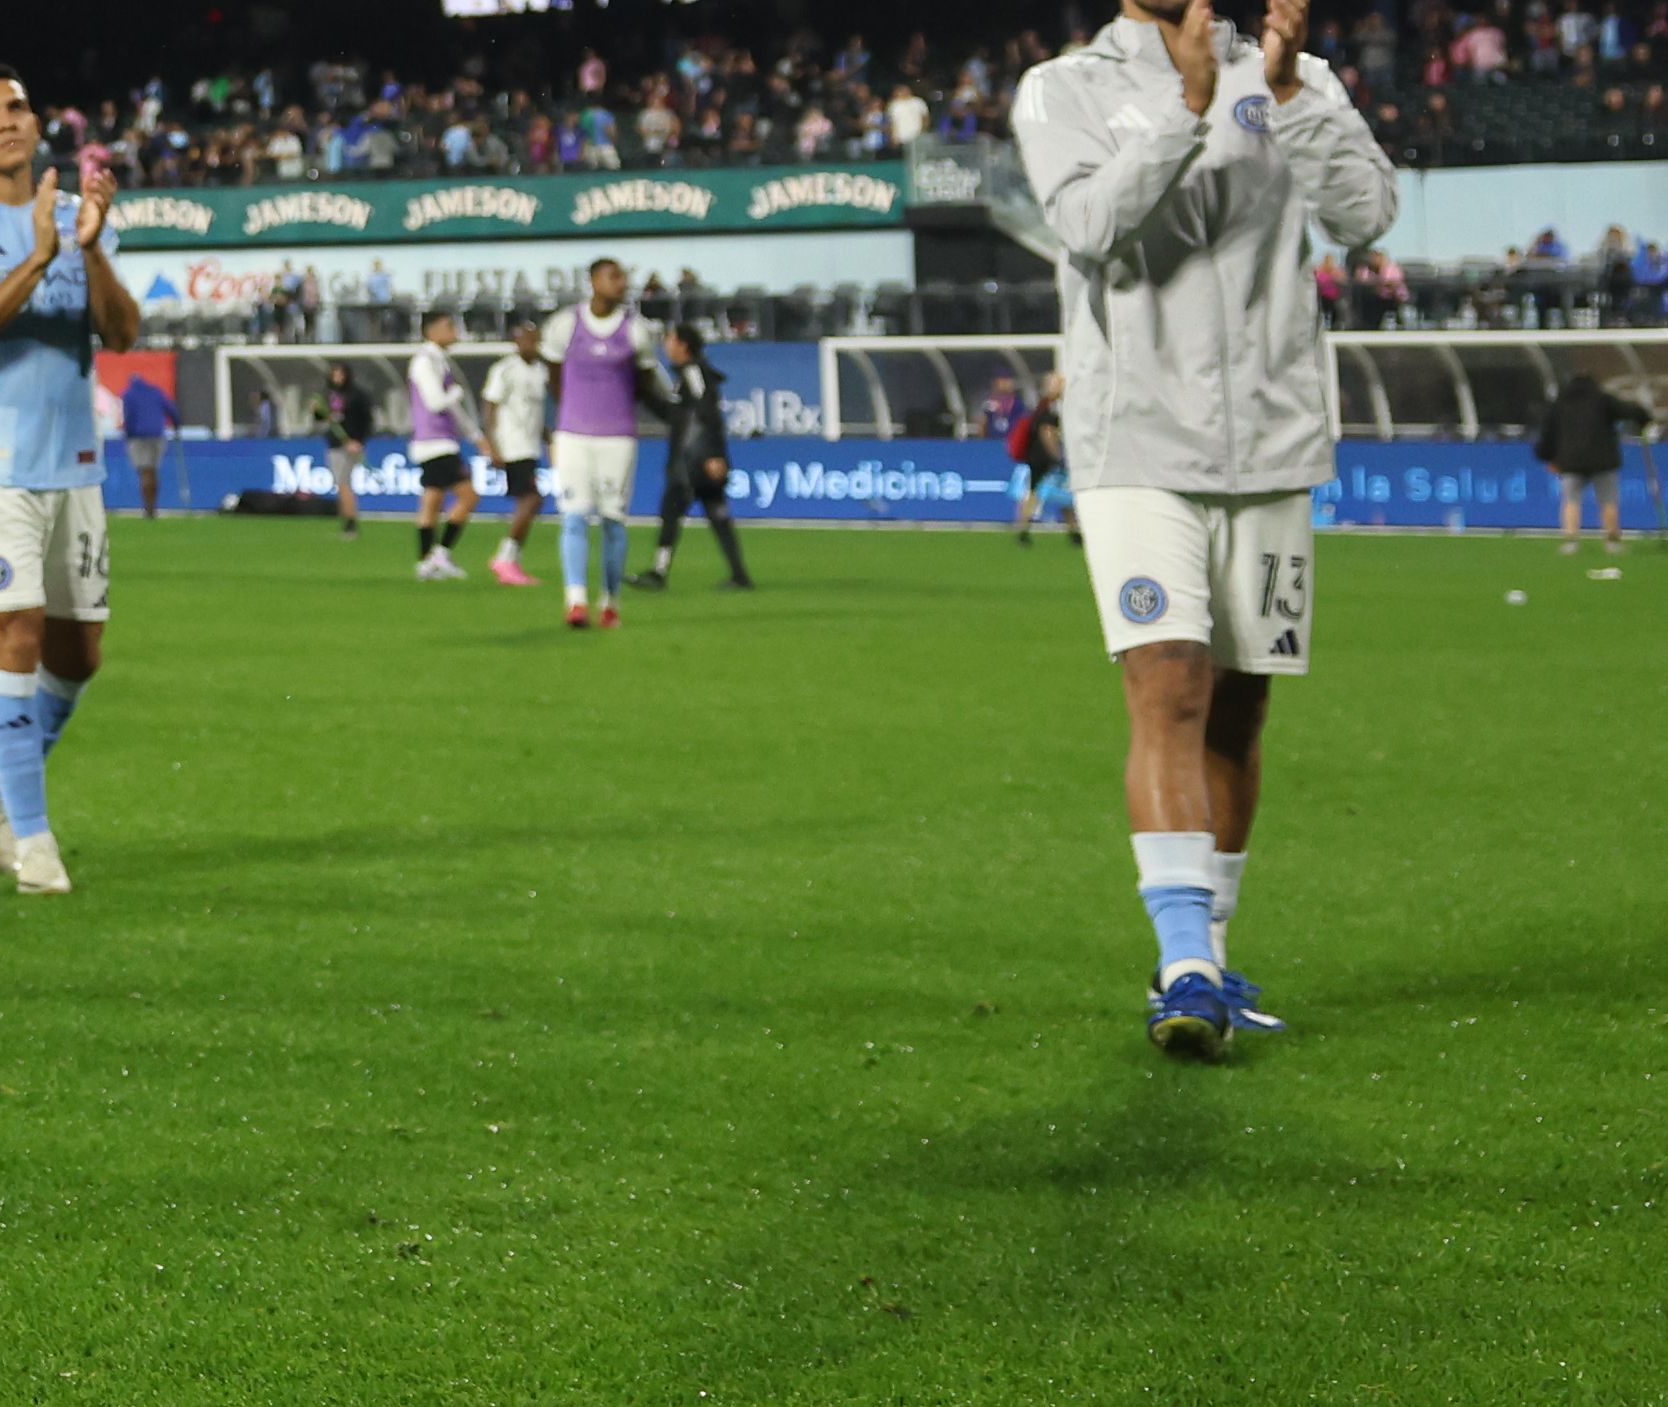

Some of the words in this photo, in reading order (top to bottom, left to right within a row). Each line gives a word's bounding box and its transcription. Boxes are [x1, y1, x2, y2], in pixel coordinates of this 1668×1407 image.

[107, 196, 214, 235] AMESON
[242, 191, 372, 236] JAMESON
[402, 185, 541, 232] JAMESON
[571, 178, 714, 226] JAMESON
[747, 172, 898, 220] JAMESON
[1403, 466, 1527, 503] Salud
[1259, 552, 1307, 620] 13
